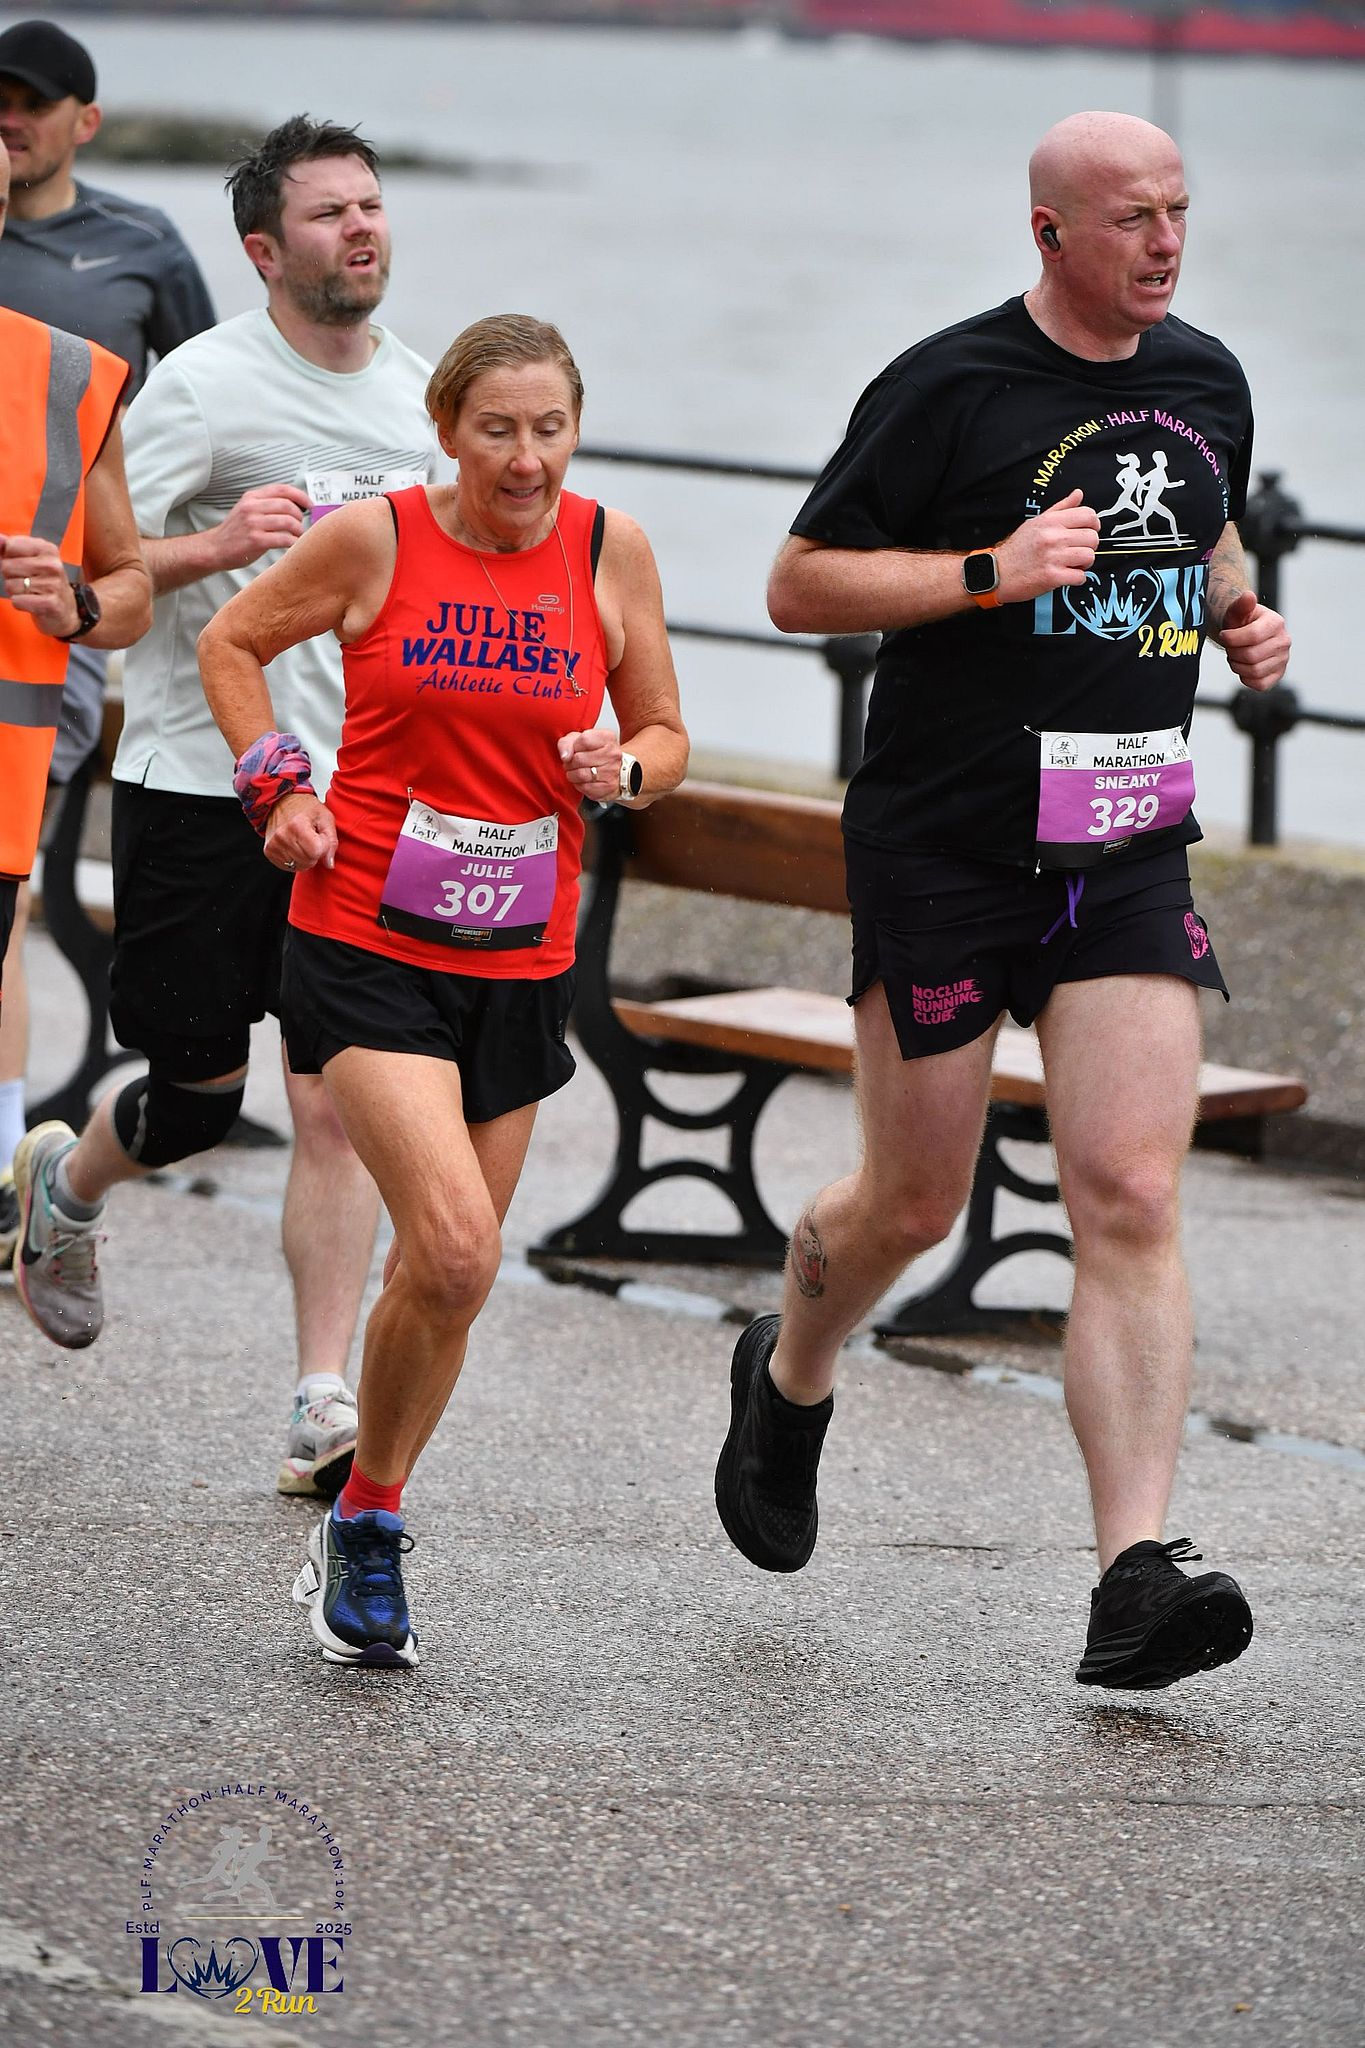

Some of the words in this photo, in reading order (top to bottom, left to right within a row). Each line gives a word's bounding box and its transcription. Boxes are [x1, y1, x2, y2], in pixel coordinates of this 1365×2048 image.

[1106, 409, 1150, 427] HALF
[1032, 419, 1102, 488] MARATHON
[1153, 408, 1221, 477] MARATHON
[353, 475, 385, 486] HALF
[341, 492, 385, 502] MARAT
[1024, 497, 1042, 519] LF
[426, 601, 546, 644] JULIE
[1138, 624, 1154, 658] 2
[402, 636, 581, 678] WALLASEY
[416, 668, 503, 694] Athletic
[513, 675, 562, 700] Club
[1116, 736, 1149, 750] HALF
[1093, 752, 1165, 768] MARATHON
[1094, 772, 1161, 790] SNEAKY
[1086, 794, 1160, 836] 329
[478, 825, 516, 841] HALF
[452, 839, 527, 858] MARATHON
[460, 862, 515, 879] JULIE
[433, 880, 524, 922] 307
[912, 991, 983, 1013] RUNNING
